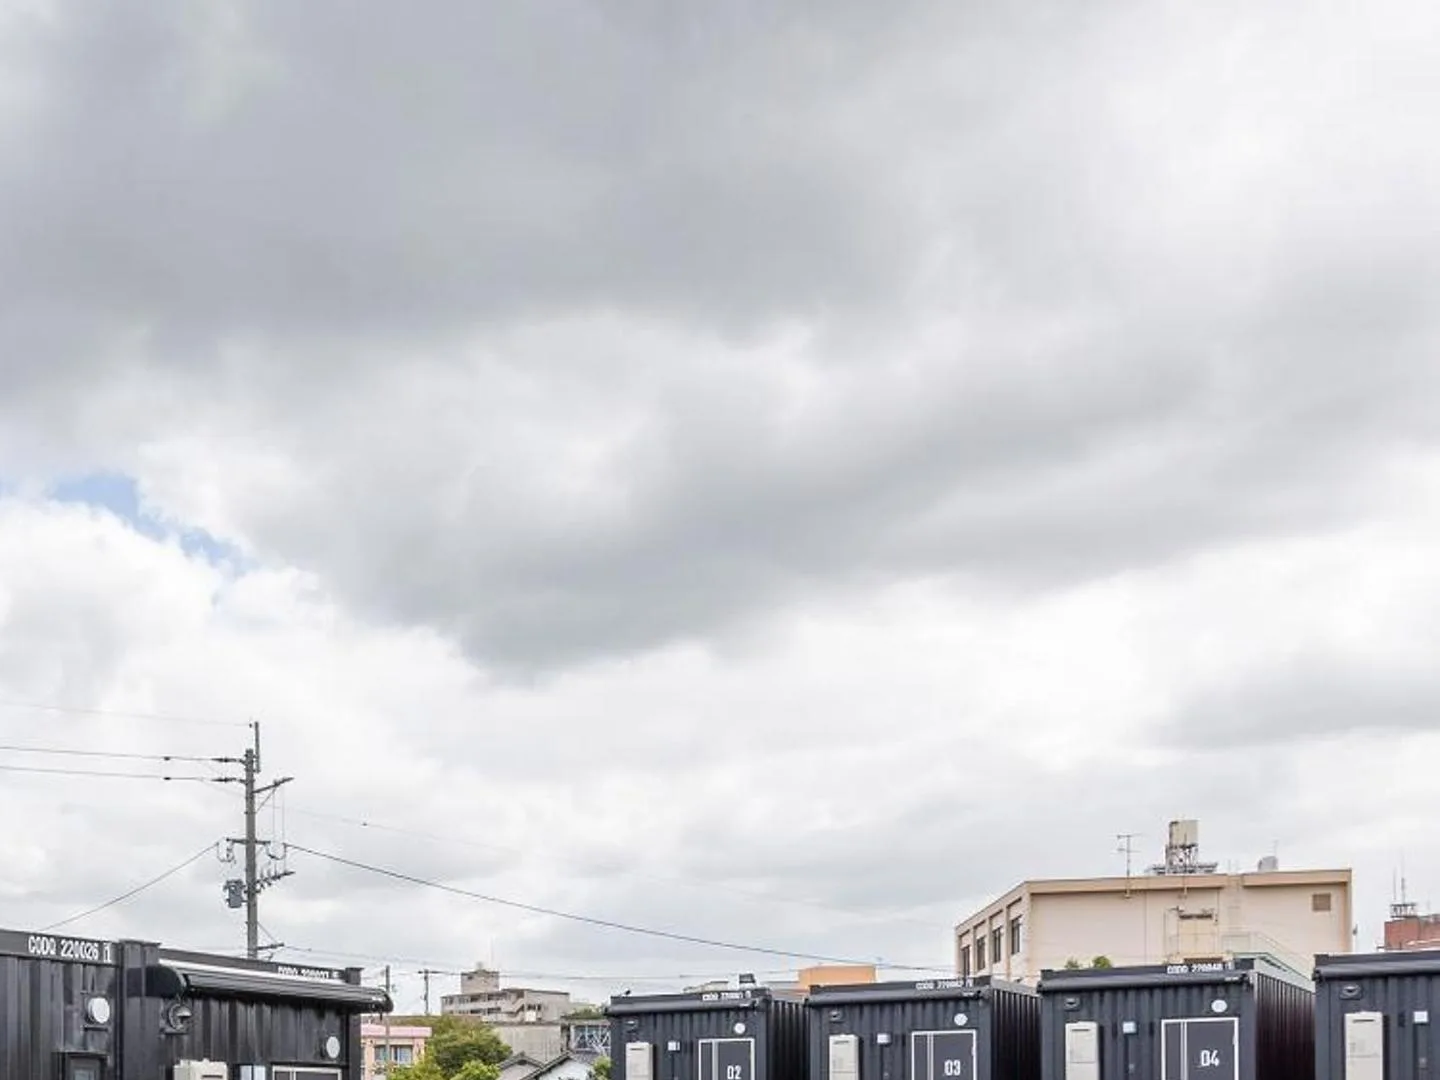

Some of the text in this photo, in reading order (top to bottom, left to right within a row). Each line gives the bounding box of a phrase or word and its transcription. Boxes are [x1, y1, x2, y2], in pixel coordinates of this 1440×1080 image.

[1201, 1049, 1219, 1066] 04
[727, 1064, 742, 1080] 02
[944, 1059, 961, 1076] 03
